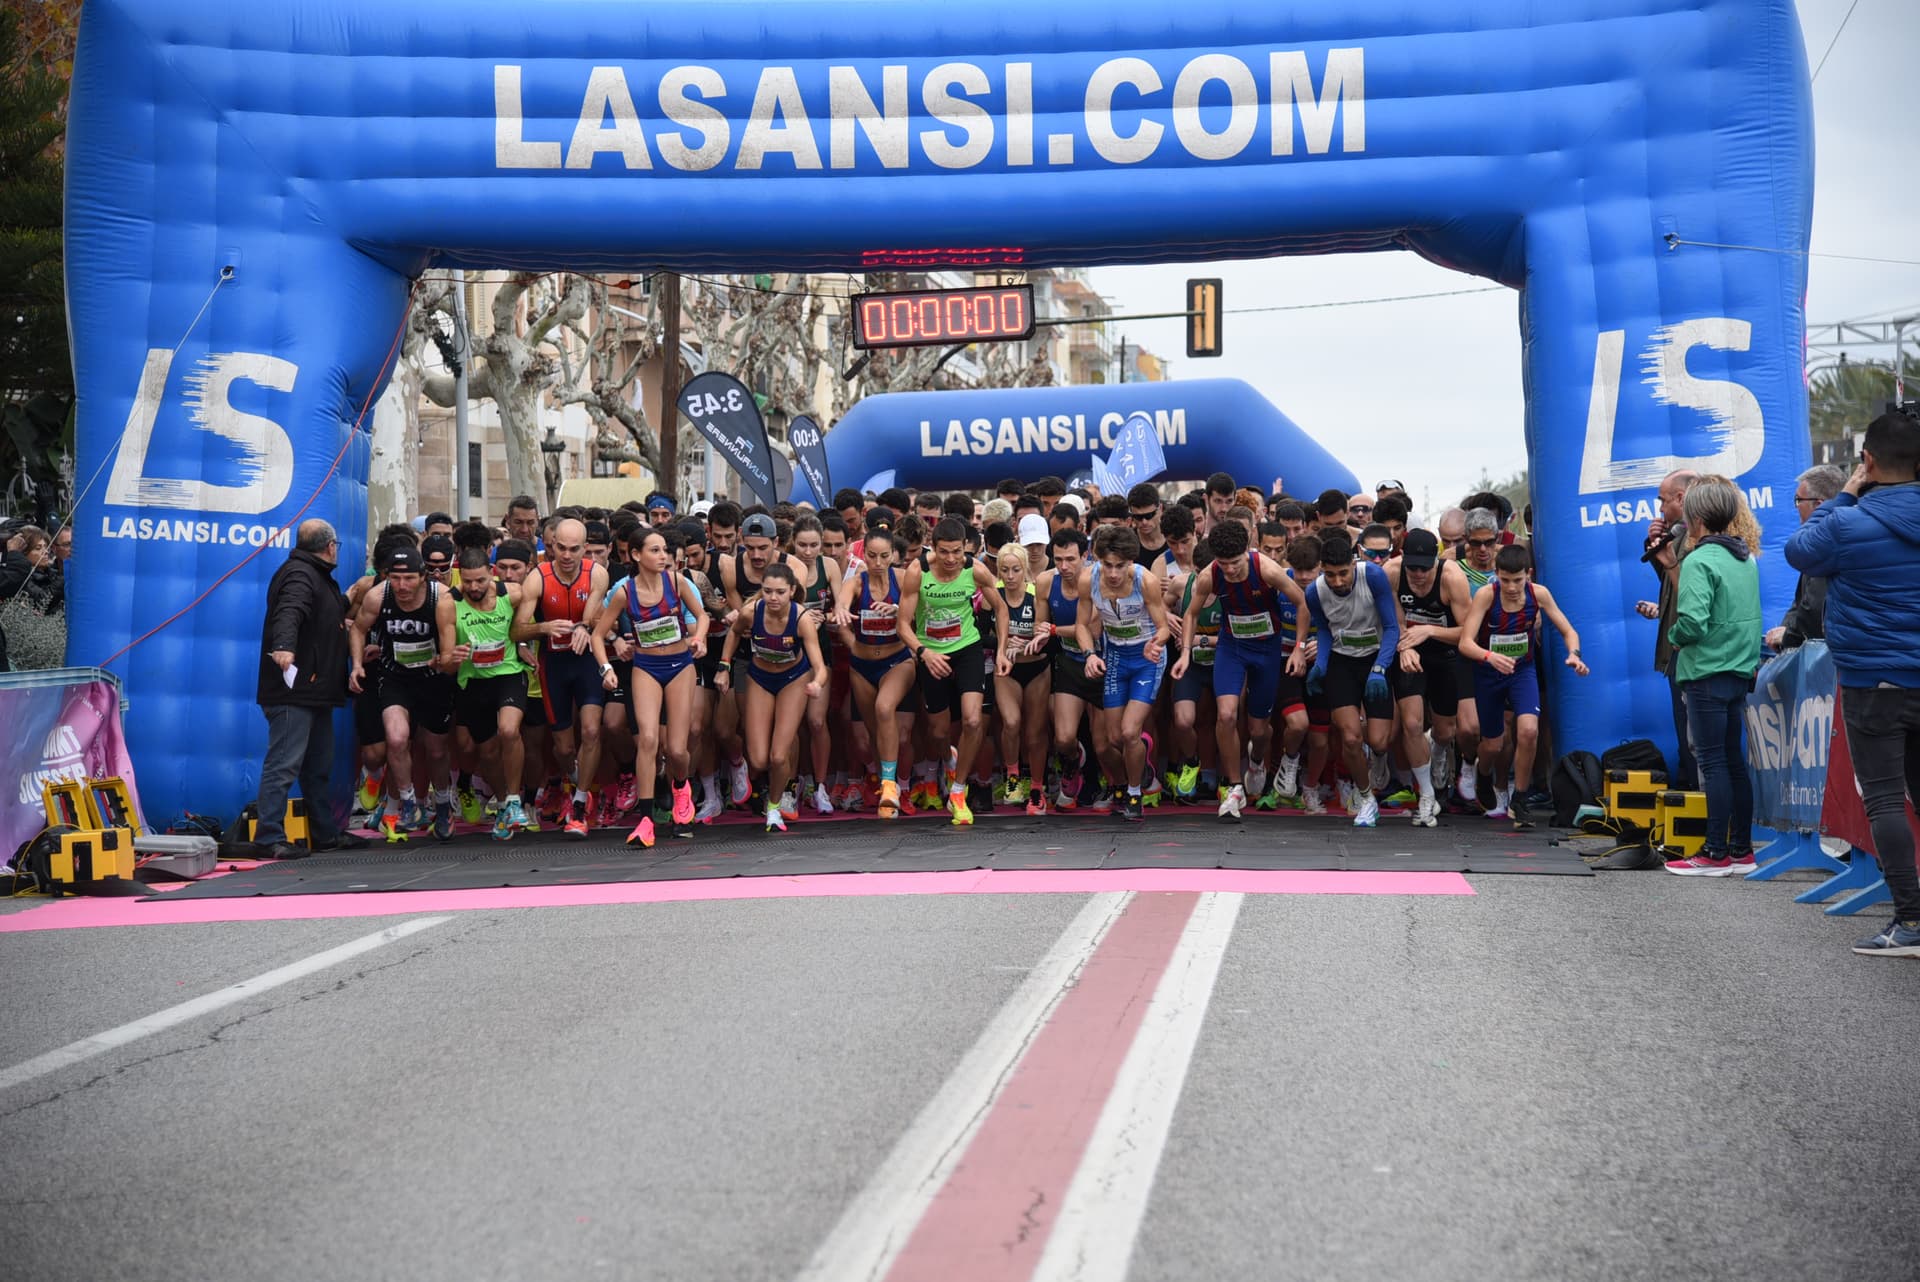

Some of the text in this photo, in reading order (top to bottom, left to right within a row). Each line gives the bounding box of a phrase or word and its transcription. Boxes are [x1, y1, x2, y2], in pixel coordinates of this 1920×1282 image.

[494, 47, 1366, 171] LASANSI.COM
[864, 294, 1023, 340] 00:00:00
[1579, 317, 1765, 495] LS
[104, 348, 299, 515] LS
[920, 408, 1188, 457] LASANSI.CM
[102, 516, 291, 548] LASANSI.COM
[925, 590, 967, 598] LASANSI.COM
[386, 619, 430, 634] HCU
[466, 615, 507, 627] LASANSI.COM
[43, 725, 82, 759] SANT
